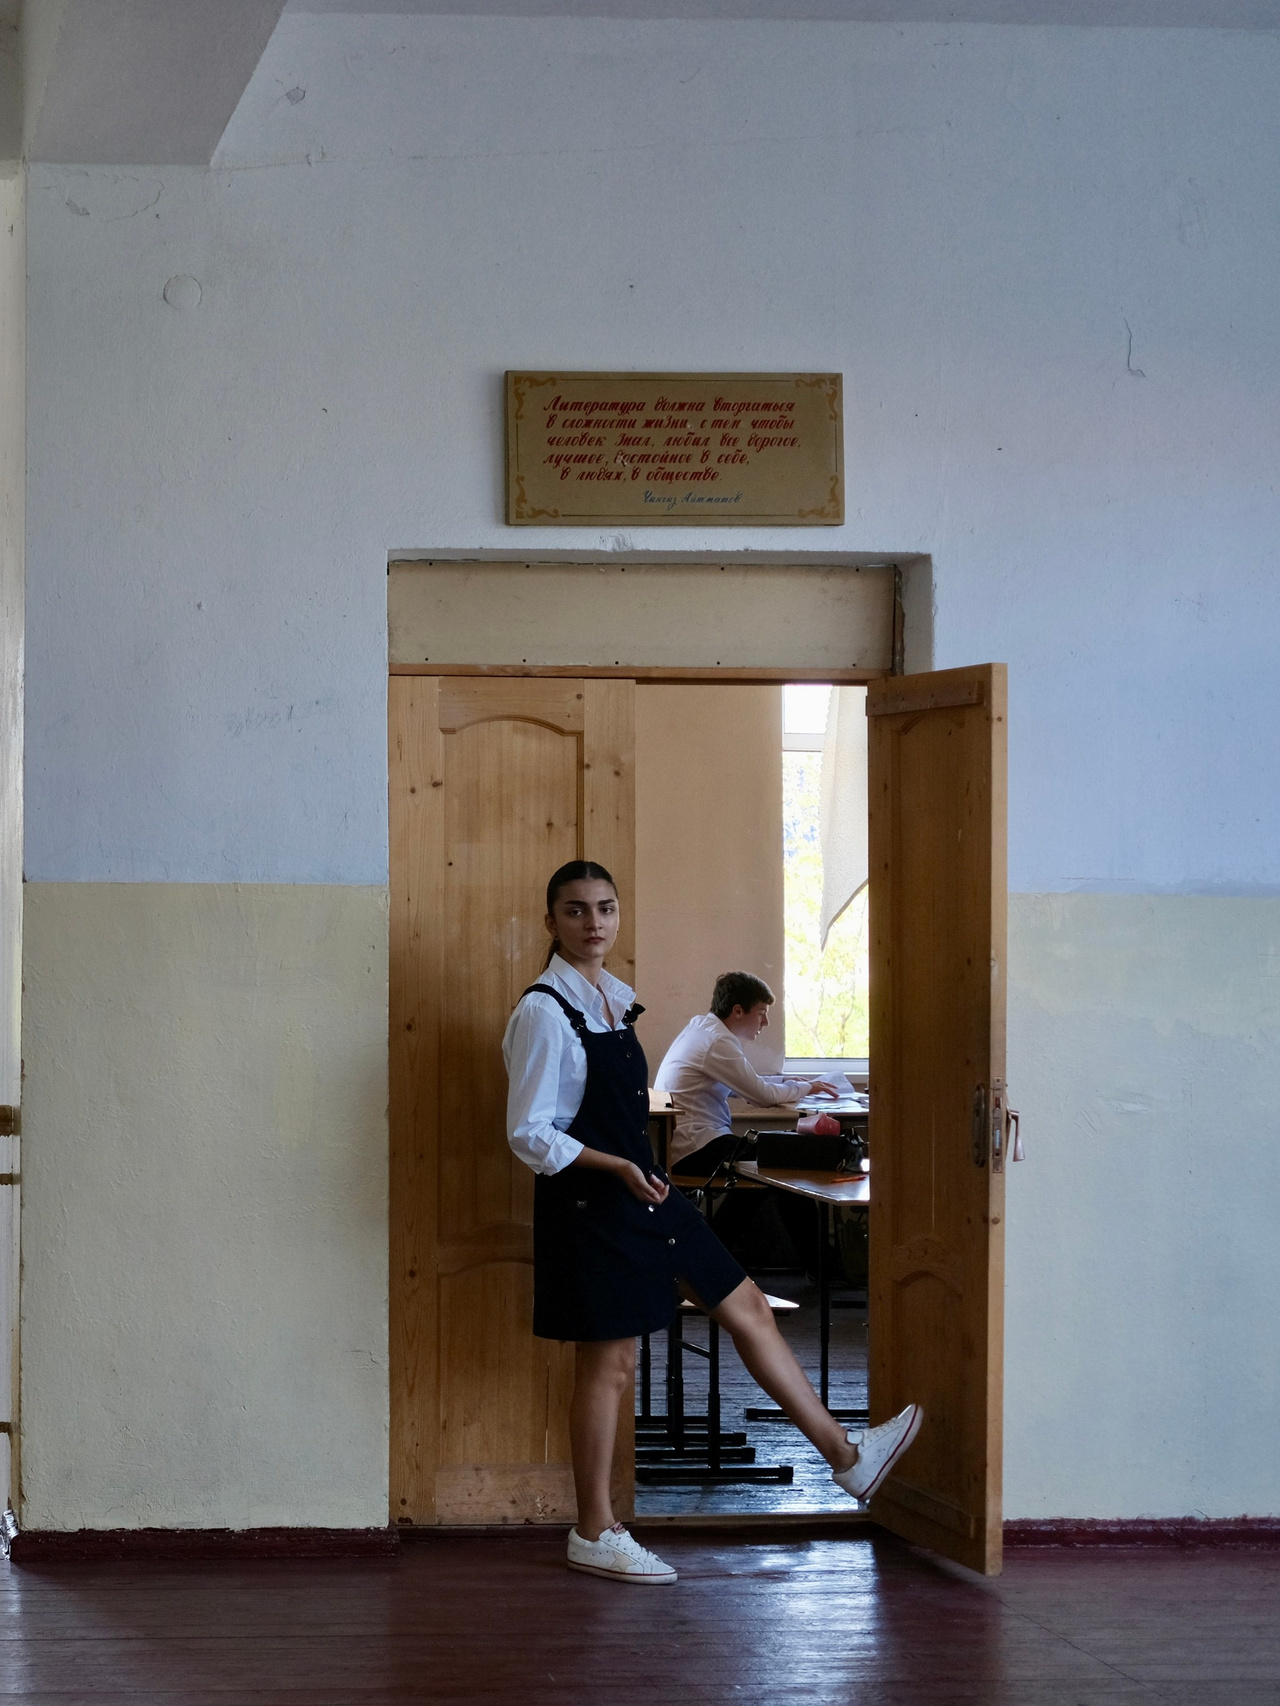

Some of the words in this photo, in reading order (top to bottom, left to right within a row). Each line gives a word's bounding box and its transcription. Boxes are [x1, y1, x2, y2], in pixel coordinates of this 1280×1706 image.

[543, 395, 647, 416] Литература
[654, 396, 706, 412] должна
[713, 396, 796, 417] вторгаться
[546, 413, 558, 429] в
[561, 418, 637, 429] сложности
[700, 419, 708, 429] с
[710, 419, 741, 429] тем
[750, 415, 795, 429] чтобы
[547, 431, 607, 447] человек
[663, 432, 711, 447] любил
[720, 432, 740, 447] все
[542, 453, 609, 469] лучшее,
[613, 449, 693, 467] достойное
[700, 449, 711, 464] в
[717, 449, 750, 466] себе,
[560, 466, 571, 481] в
[631, 466, 641, 481] в
